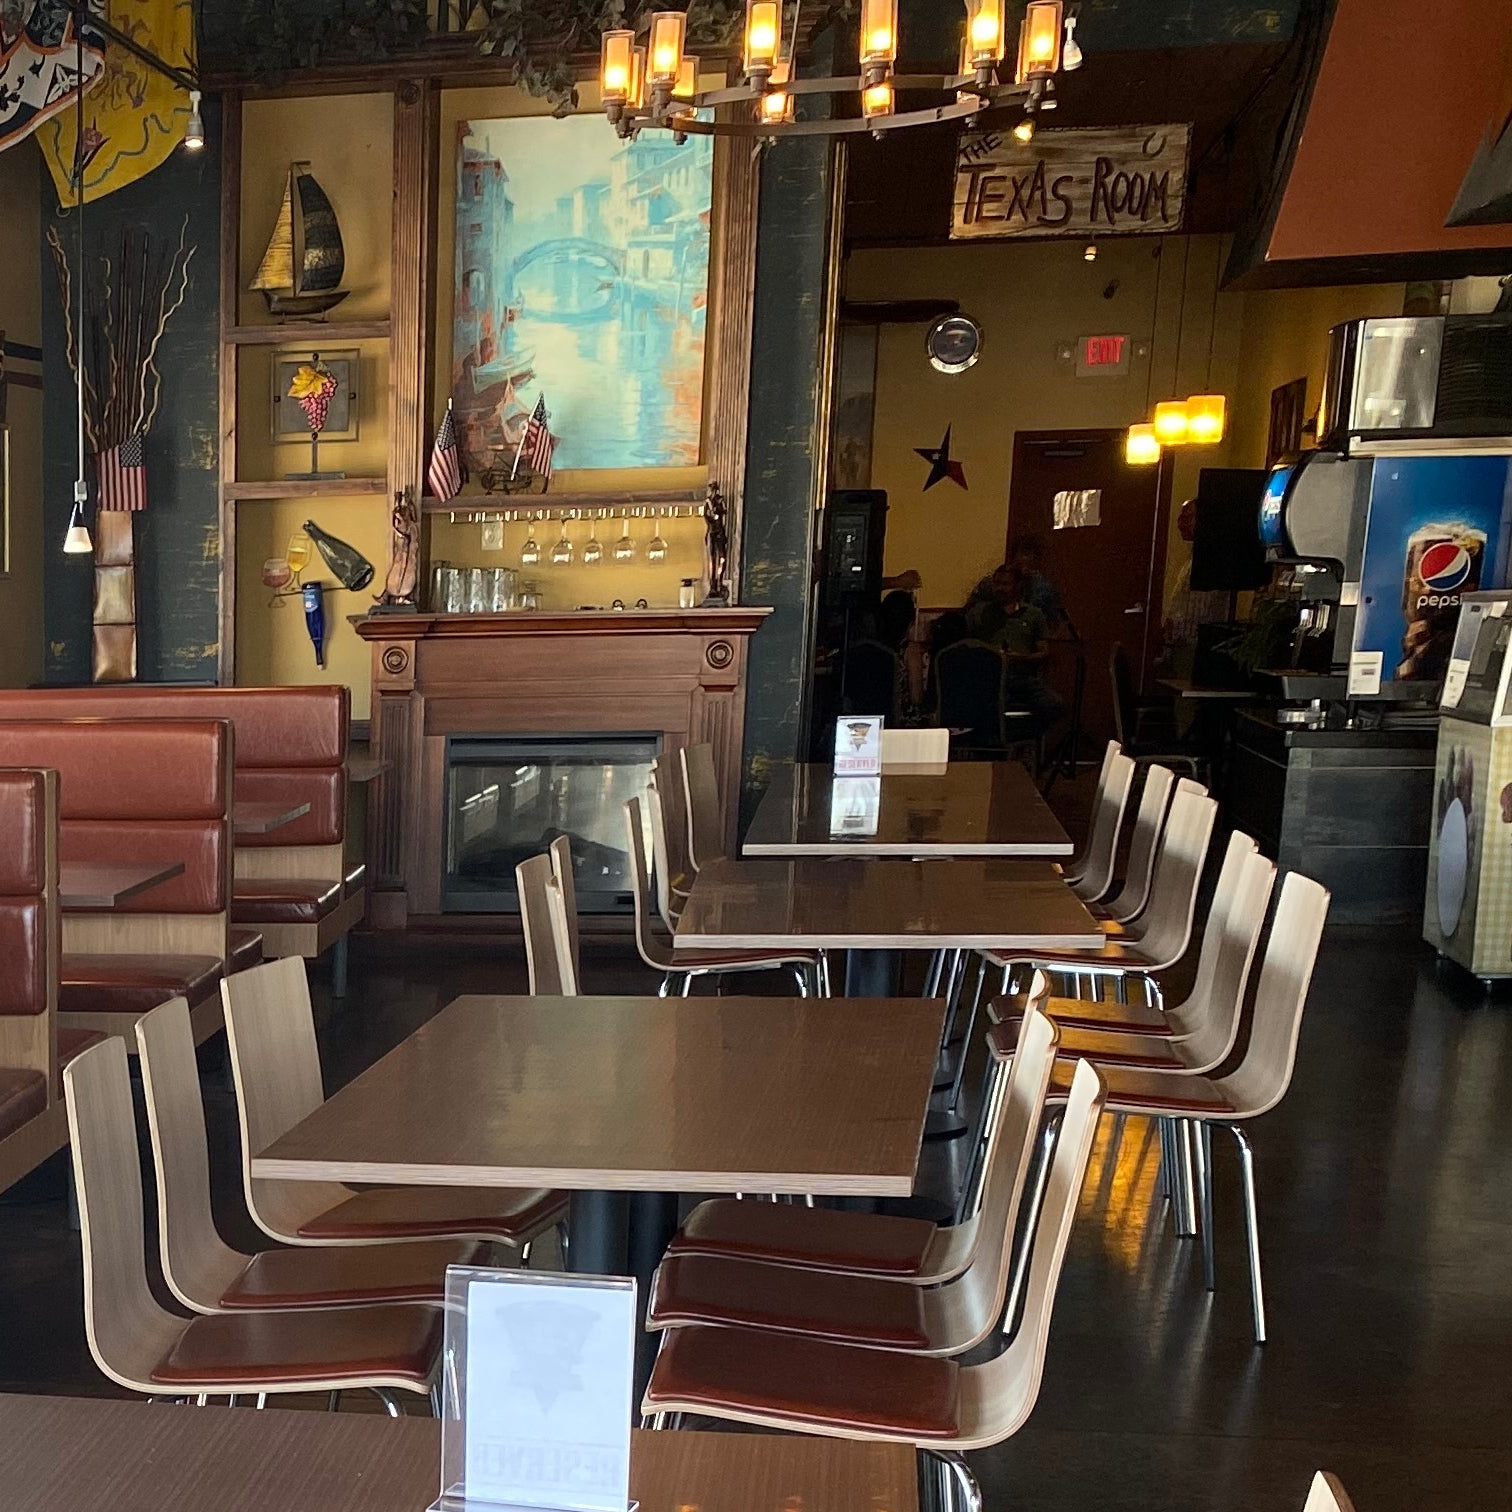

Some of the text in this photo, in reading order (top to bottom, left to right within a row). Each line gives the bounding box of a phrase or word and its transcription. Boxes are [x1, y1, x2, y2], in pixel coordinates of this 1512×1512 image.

[959, 133, 1004, 164] THE
[959, 156, 1170, 228] TEXAS ROOM
[1087, 336, 1125, 364] EXIT
